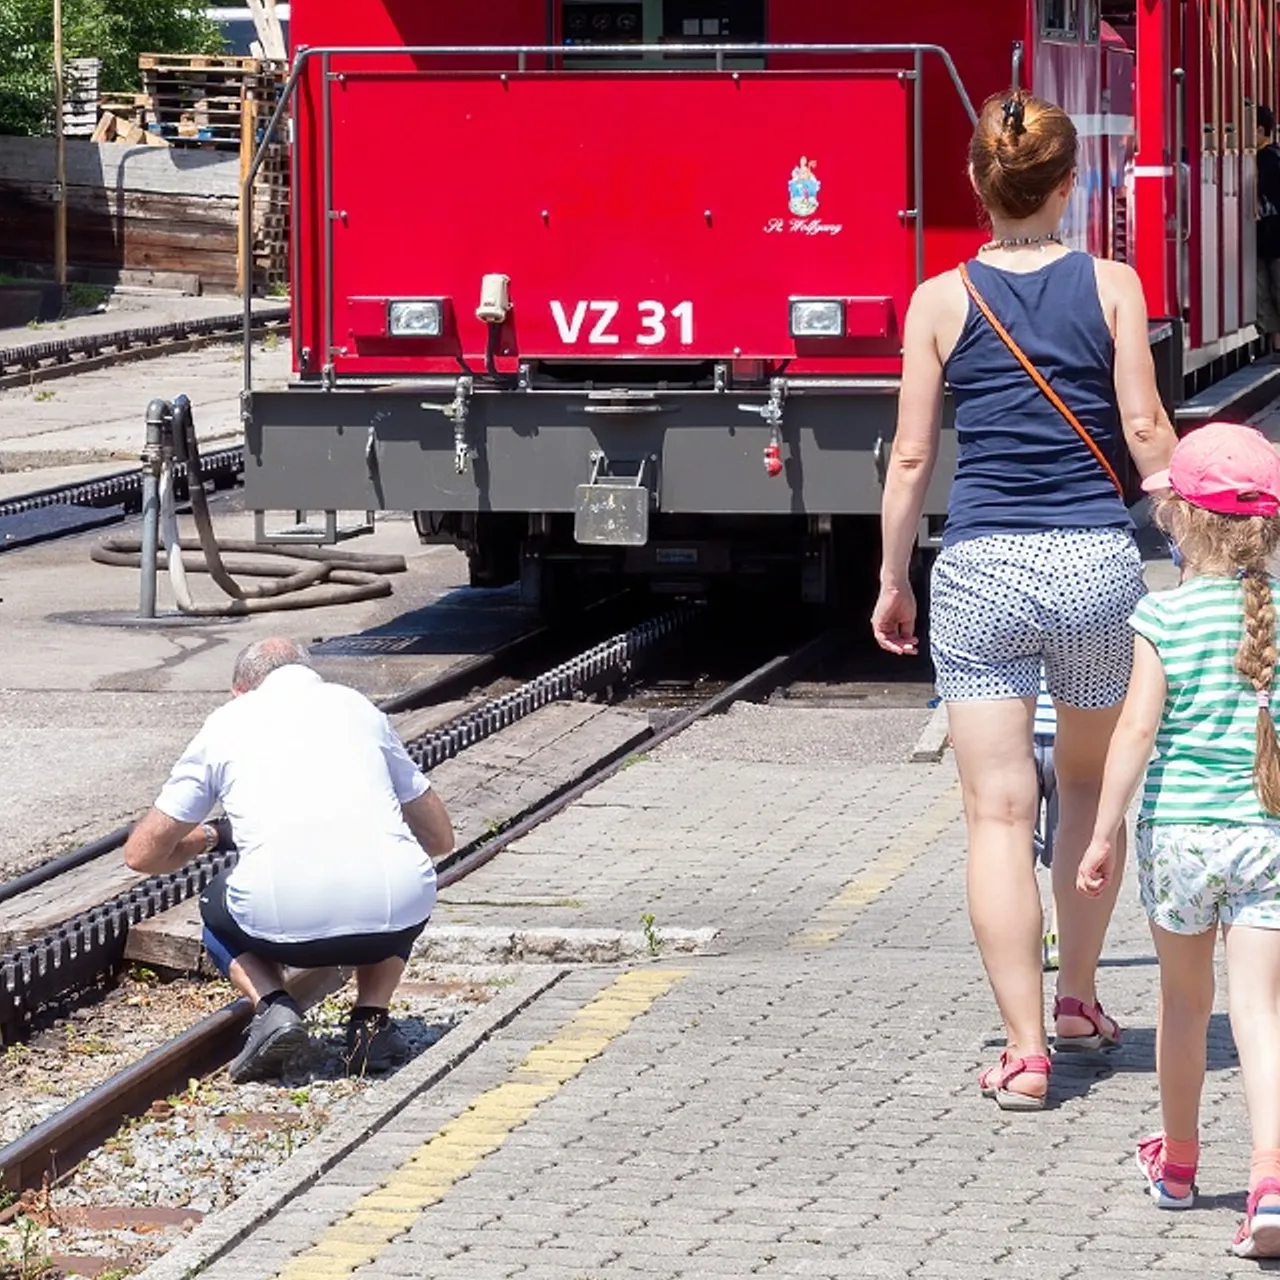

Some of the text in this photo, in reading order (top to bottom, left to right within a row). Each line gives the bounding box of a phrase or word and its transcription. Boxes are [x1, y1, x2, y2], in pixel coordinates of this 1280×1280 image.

[788, 217, 843, 236] Wolfgang
[549, 299, 694, 345] VZ 31
